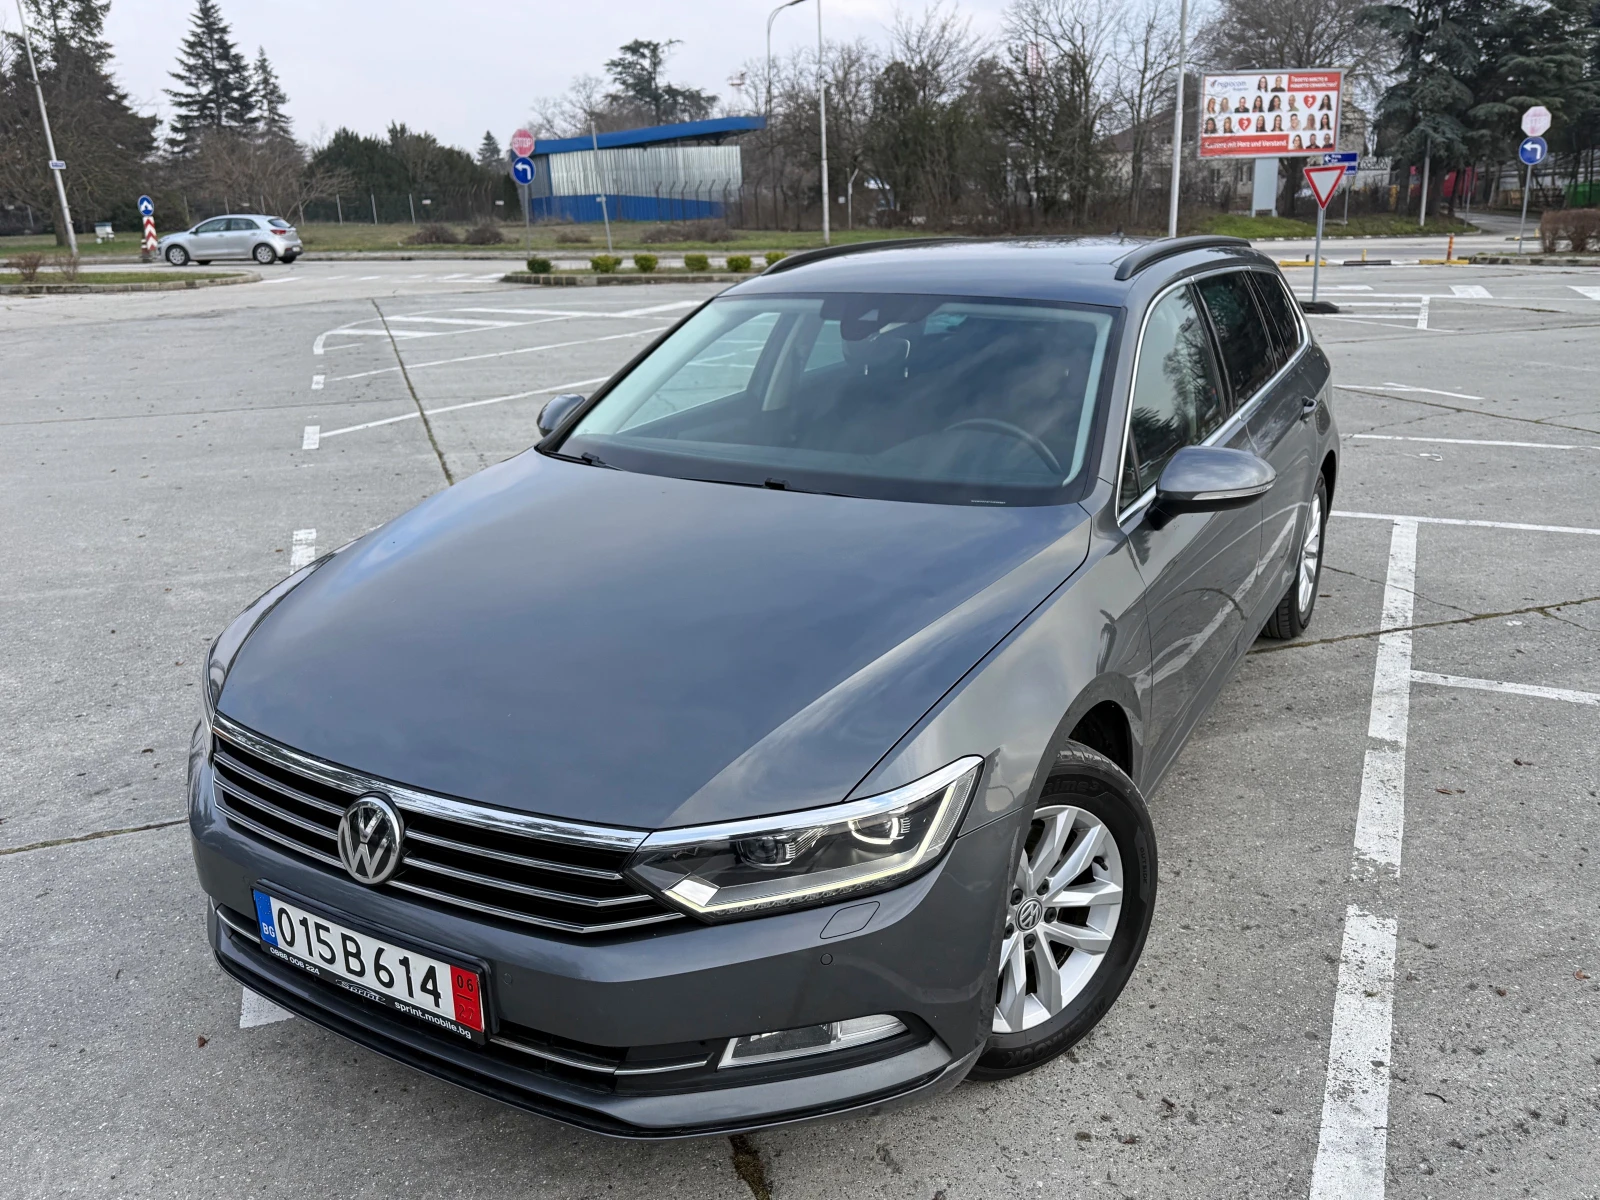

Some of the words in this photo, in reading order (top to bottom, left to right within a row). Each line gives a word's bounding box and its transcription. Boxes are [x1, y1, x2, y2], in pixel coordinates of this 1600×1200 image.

[514, 138, 532, 147] STOP
[1140, 847, 1148, 884] OUTSIDE
[262, 922, 275, 938] BG
[270, 947, 288, 960] 0888
[305, 964, 320, 975] 224
[277, 907, 442, 1009] 015B614
[457, 974, 474, 992] 06
[394, 1002, 471, 1039] sprint.mobile.bg
